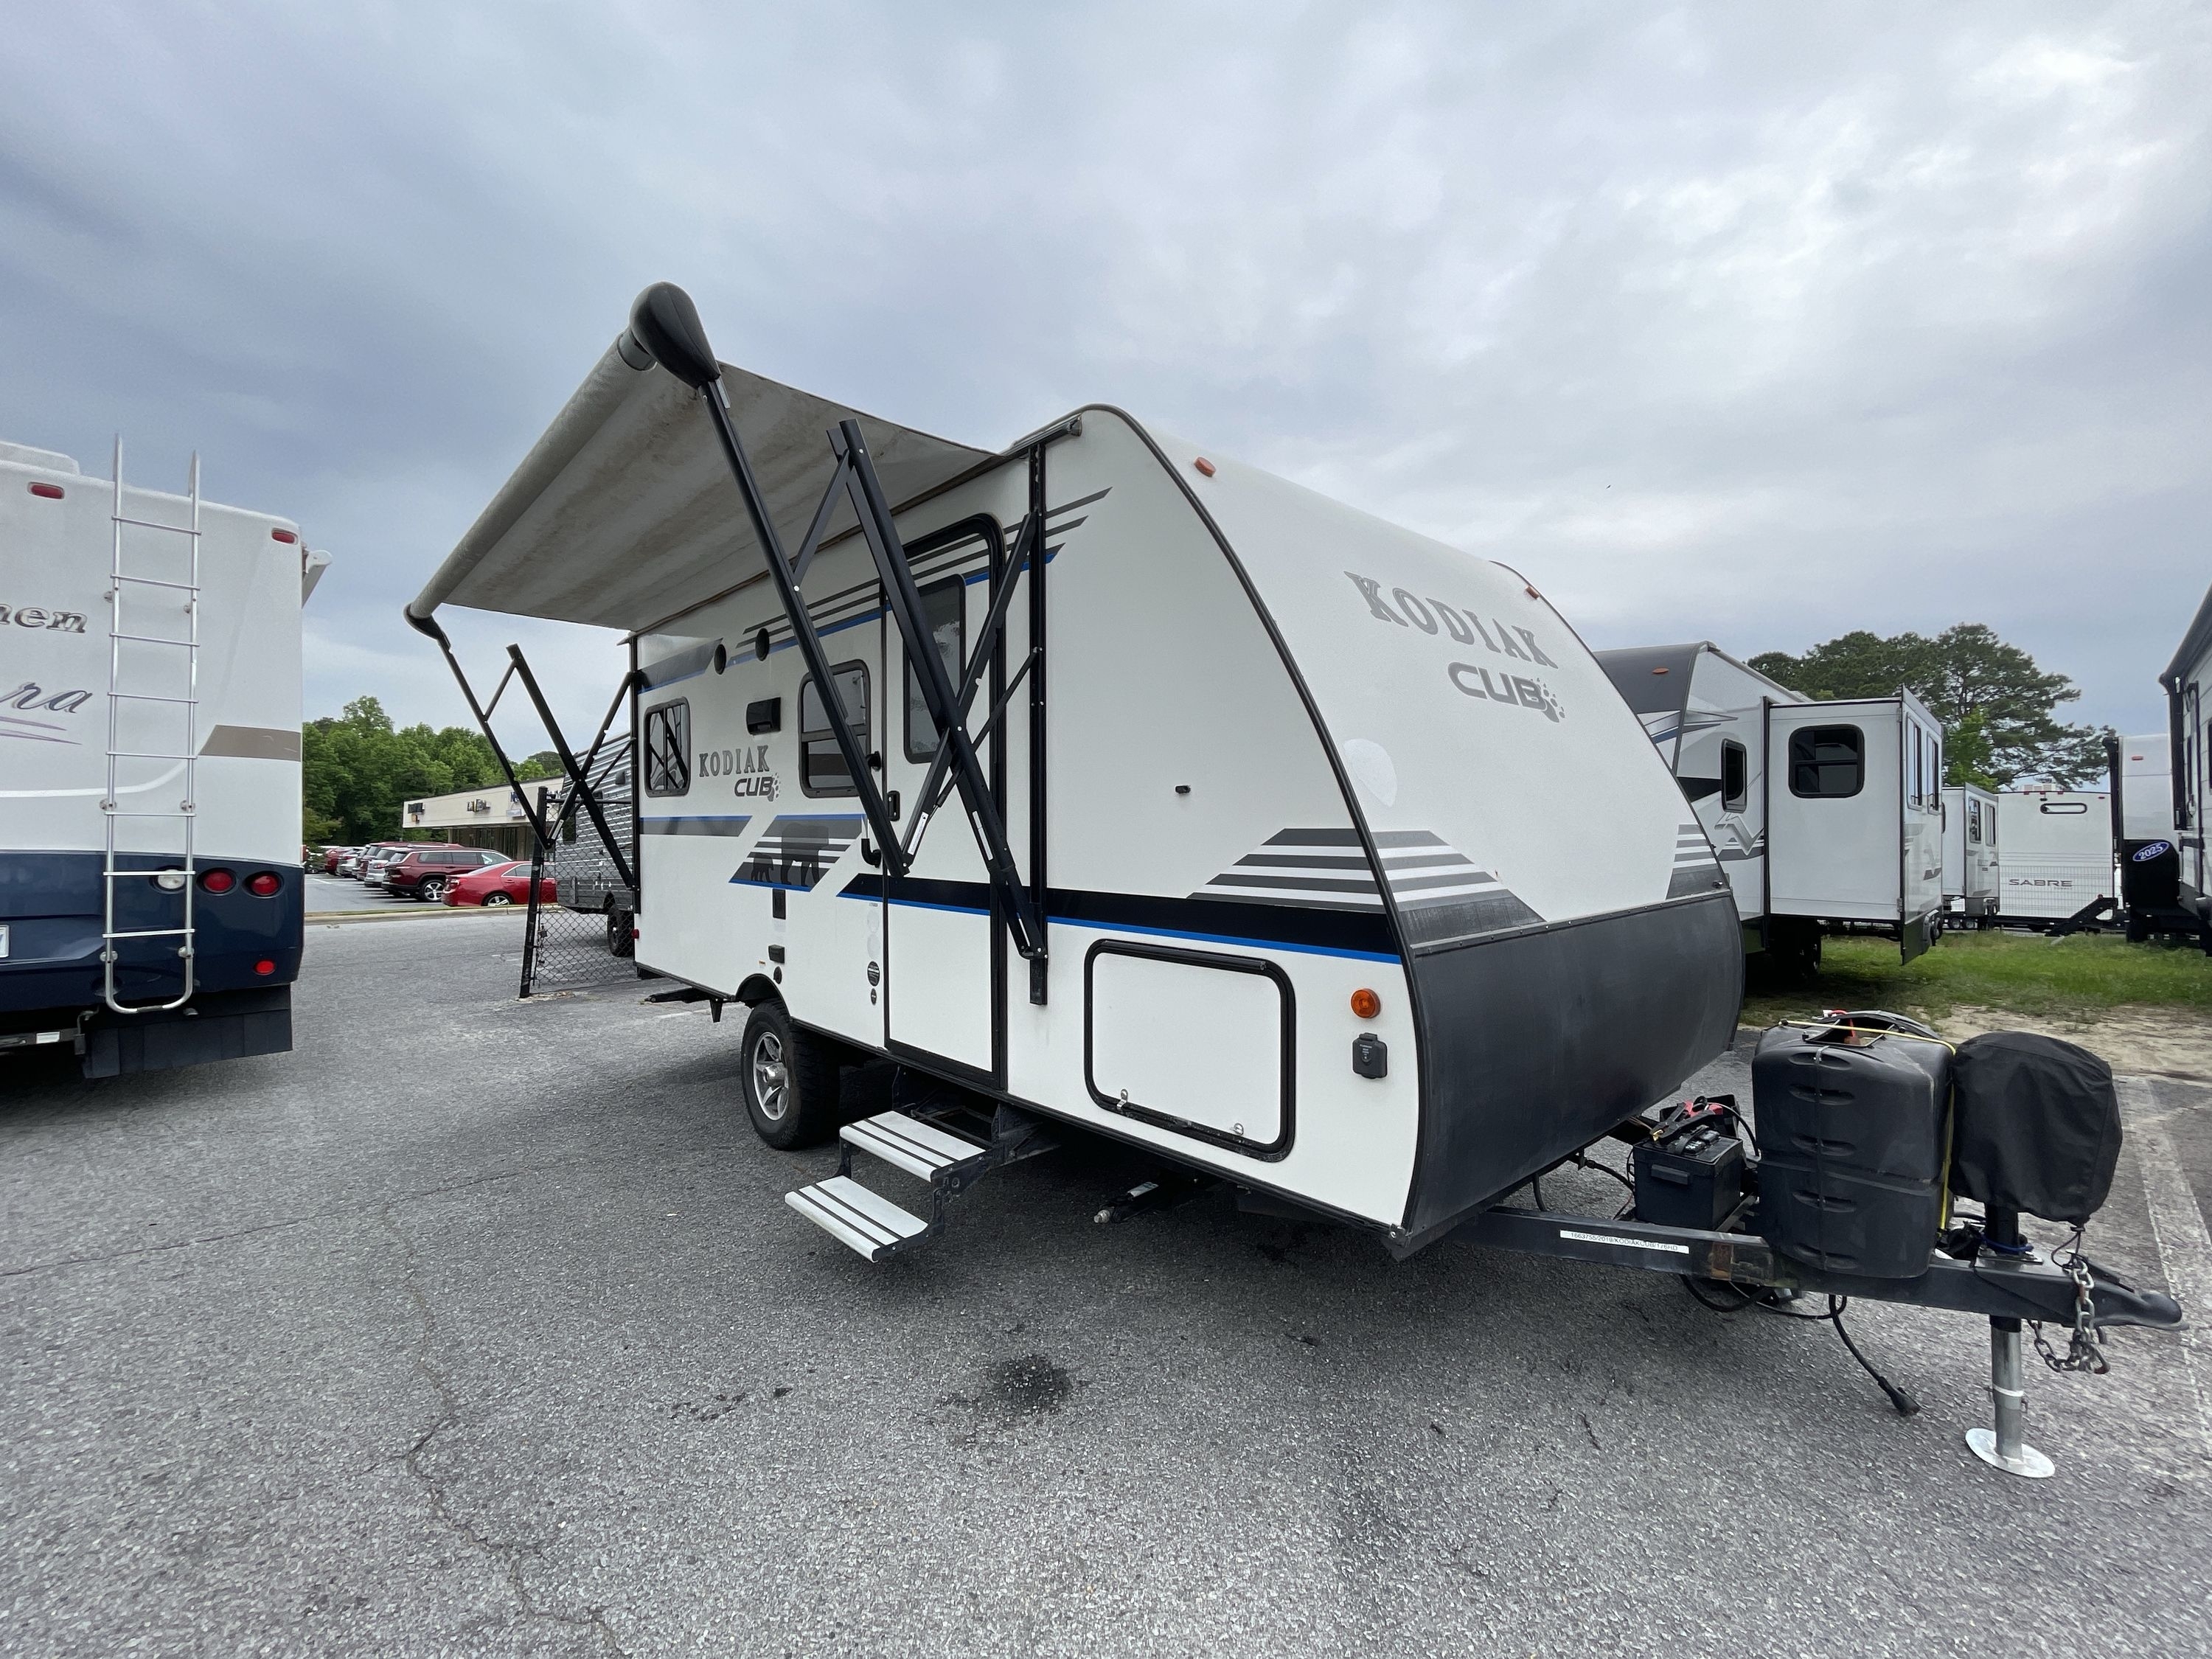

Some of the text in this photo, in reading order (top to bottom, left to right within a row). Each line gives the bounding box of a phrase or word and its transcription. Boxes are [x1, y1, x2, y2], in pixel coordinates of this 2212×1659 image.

[0, 603, 88, 633] en
[1343, 571, 1559, 669] KODIAK
[1447, 661, 1548, 711] CUB
[699, 745, 770, 777] KODIAK
[734, 776, 773, 796] CUB
[2138, 844, 2163, 860] 2025
[2008, 879, 2073, 887] SABRE
